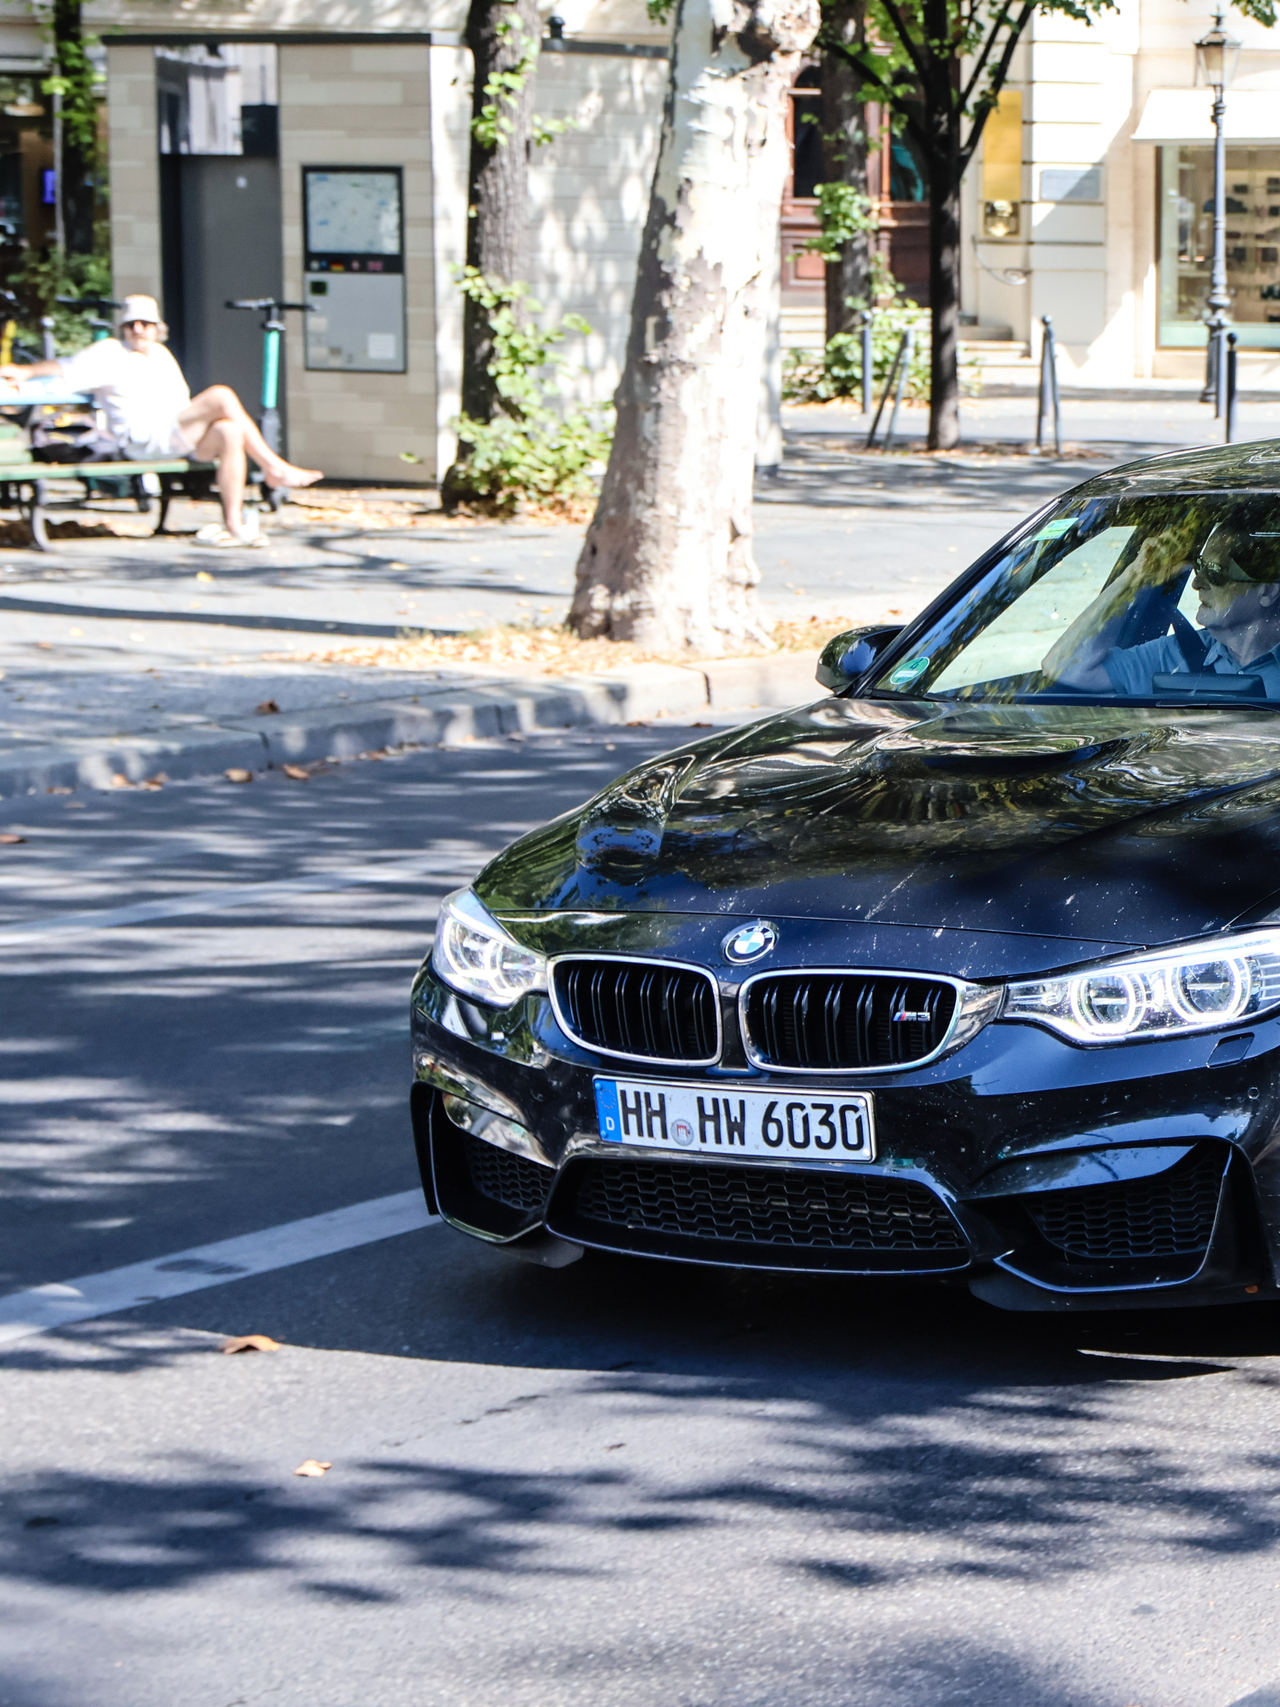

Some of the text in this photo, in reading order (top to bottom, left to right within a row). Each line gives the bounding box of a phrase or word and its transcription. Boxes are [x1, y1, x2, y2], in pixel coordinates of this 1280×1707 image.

[903, 1011, 931, 1022] M3
[605, 1089, 865, 1151] D HH HW 6030
